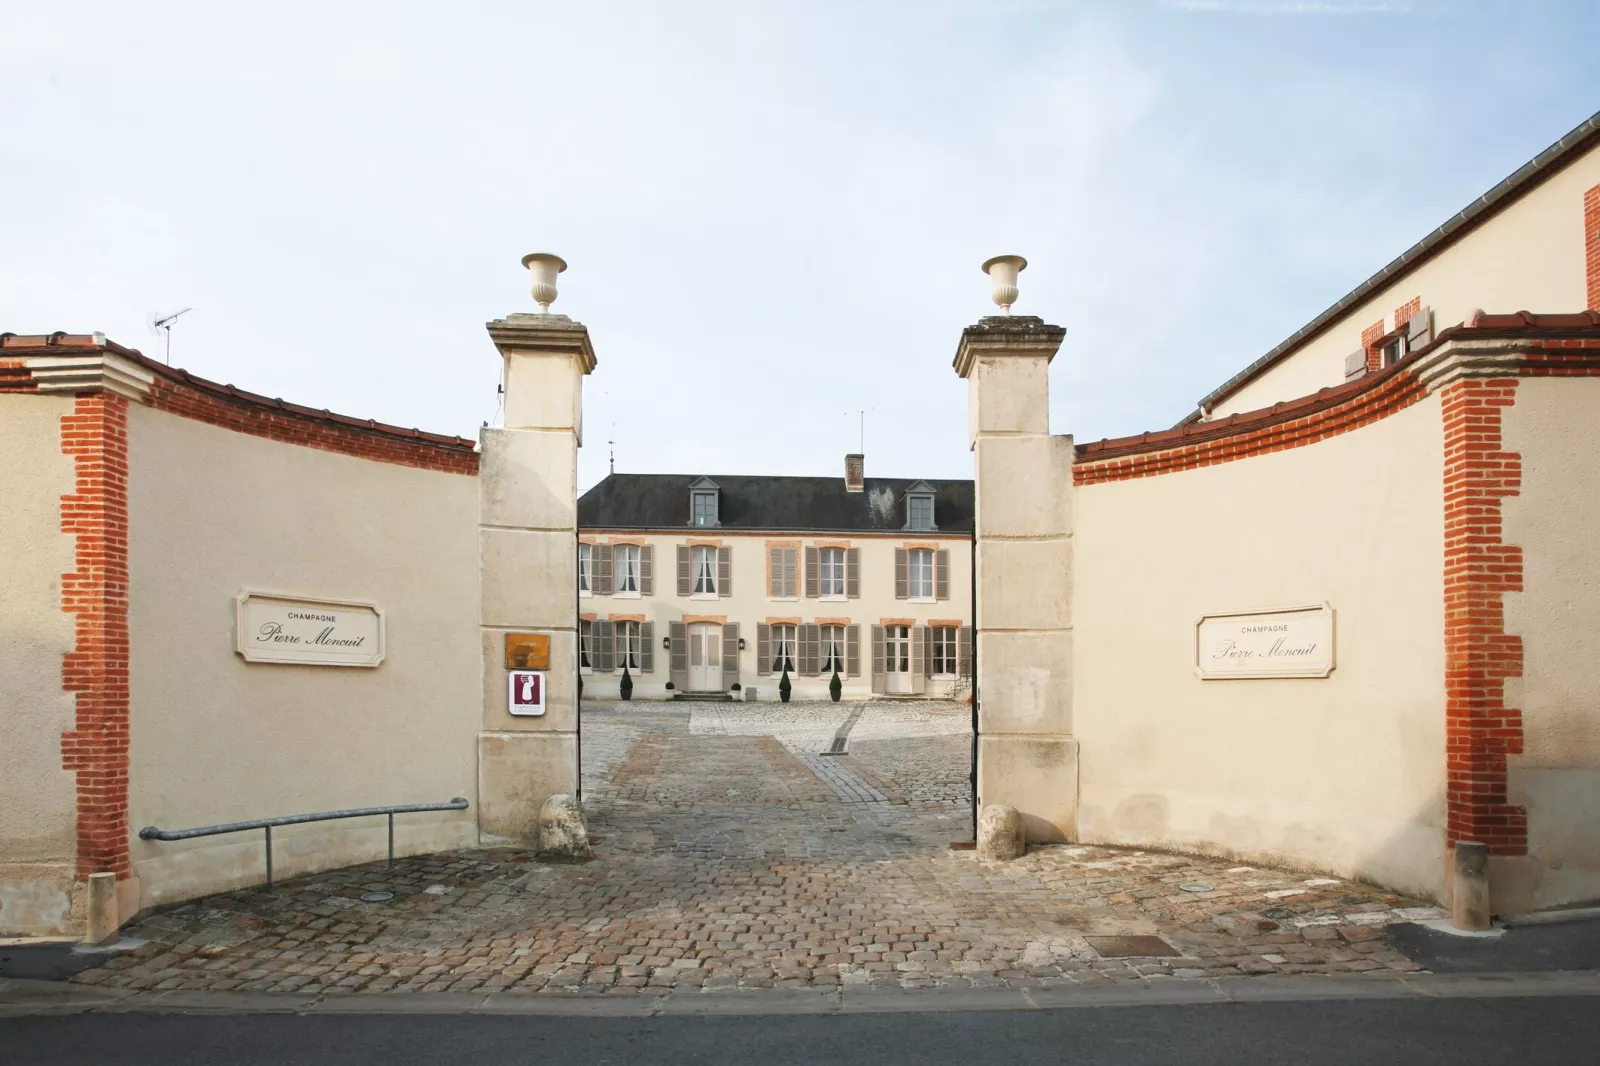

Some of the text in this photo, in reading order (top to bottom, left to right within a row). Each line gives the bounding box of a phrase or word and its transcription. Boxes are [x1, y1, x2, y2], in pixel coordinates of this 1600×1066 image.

[287, 612, 336, 622] CHAMPAGNE
[256, 622, 365, 647] Pierre Moncuit
[1241, 625, 1288, 634] CHAMPAGNE
[1212, 636, 1317, 660] Pierre Moncuit
